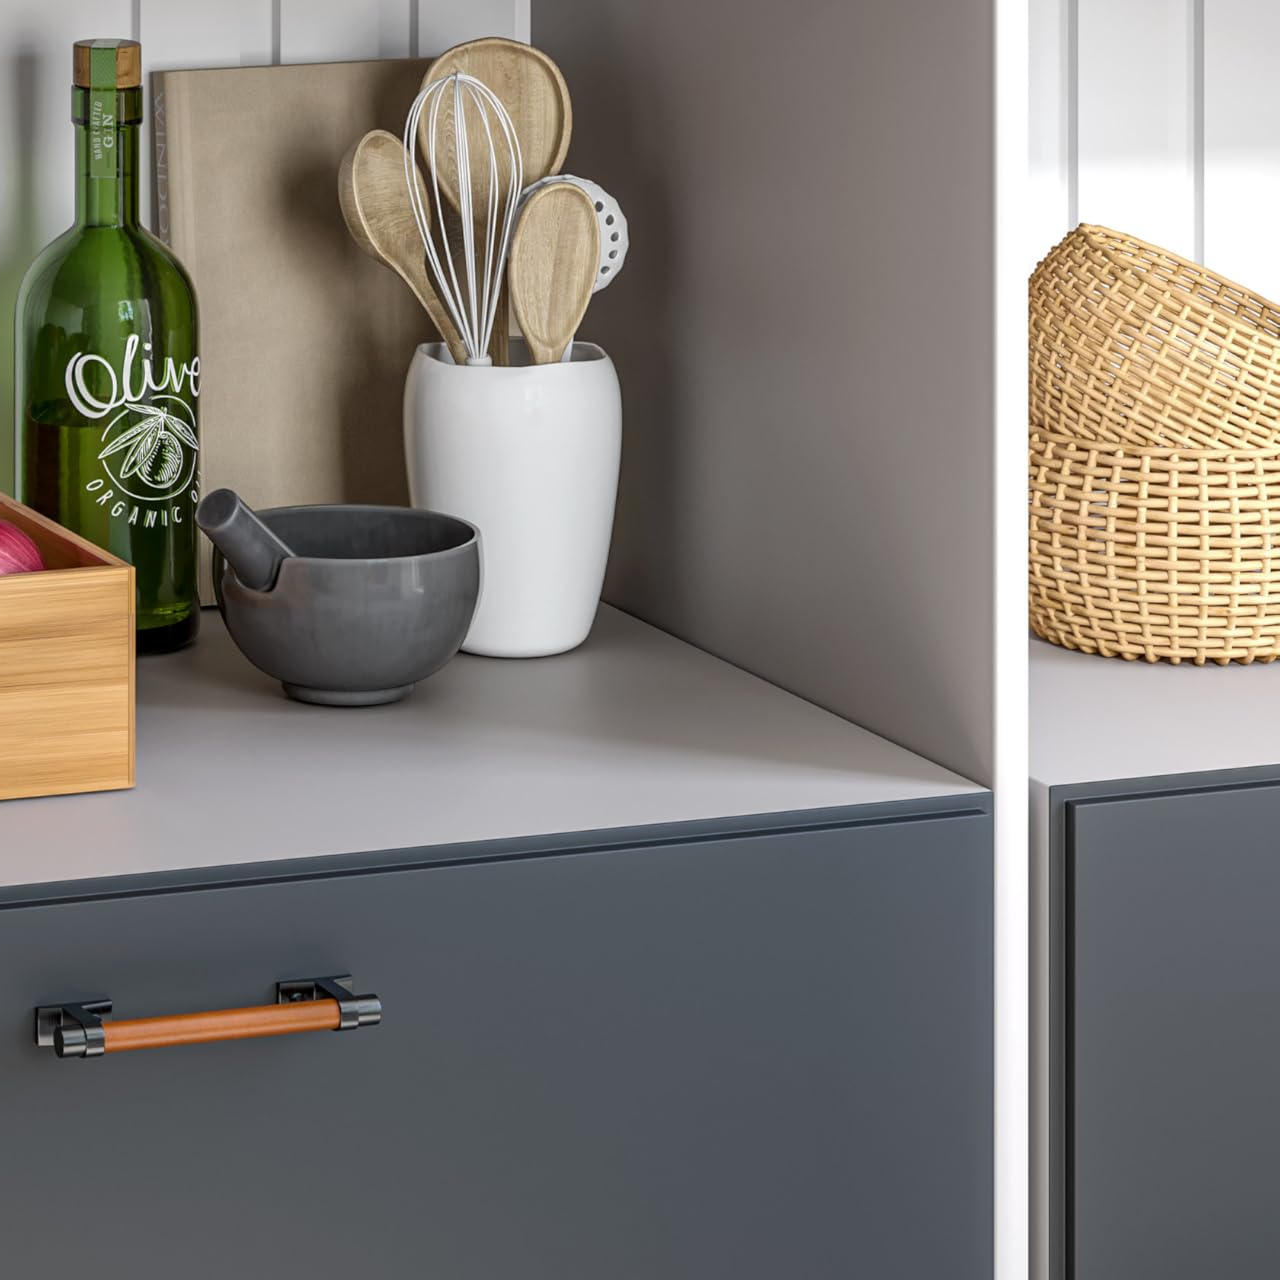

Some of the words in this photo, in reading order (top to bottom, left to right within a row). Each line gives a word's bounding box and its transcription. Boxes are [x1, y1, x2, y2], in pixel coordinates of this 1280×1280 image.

[102, 113, 114, 148] GIN
[65, 334, 202, 419] Olive
[85, 478, 183, 528] ORGANIC
